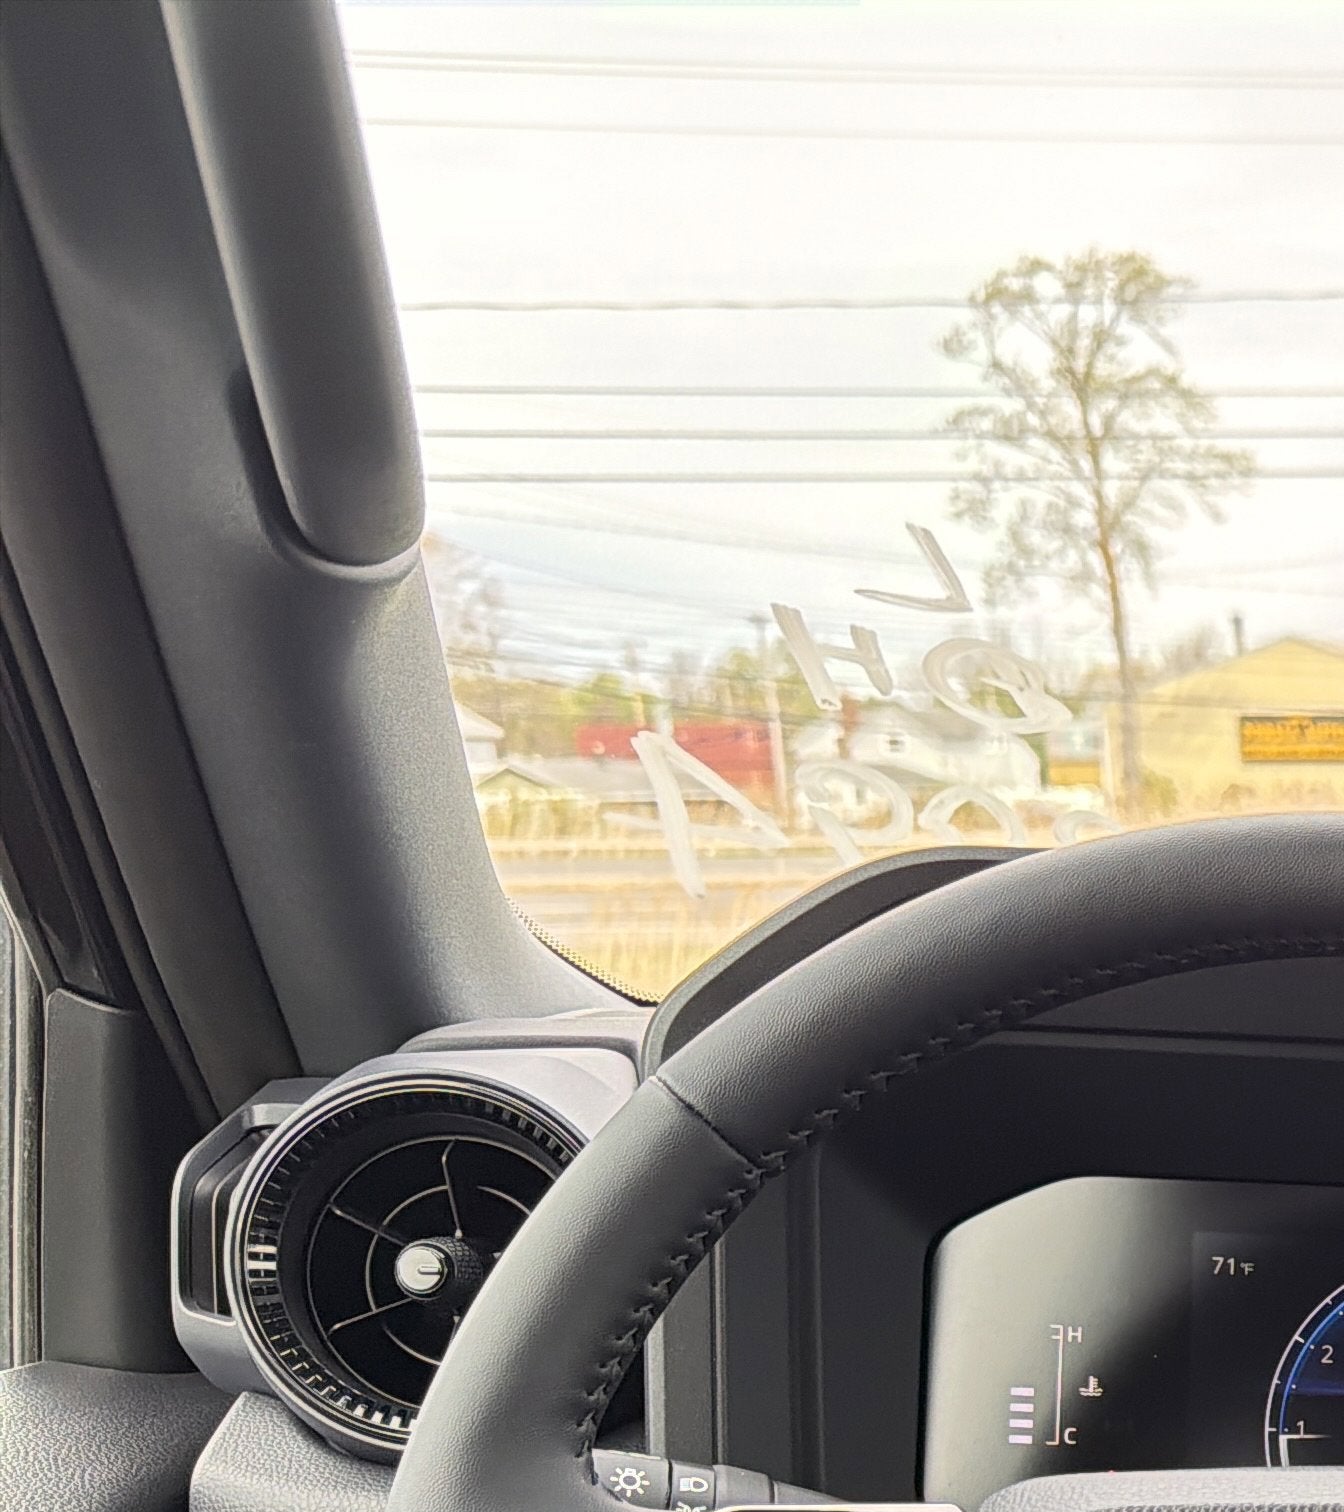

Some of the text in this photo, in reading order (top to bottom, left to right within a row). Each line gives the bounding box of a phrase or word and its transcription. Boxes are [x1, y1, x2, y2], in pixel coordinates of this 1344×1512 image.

[1068, 1326, 1083, 1343] H
[1321, 1345, 1334, 1364] 2
[1063, 1428, 1077, 1445] C
[1296, 1420, 1305, 1436] 1
